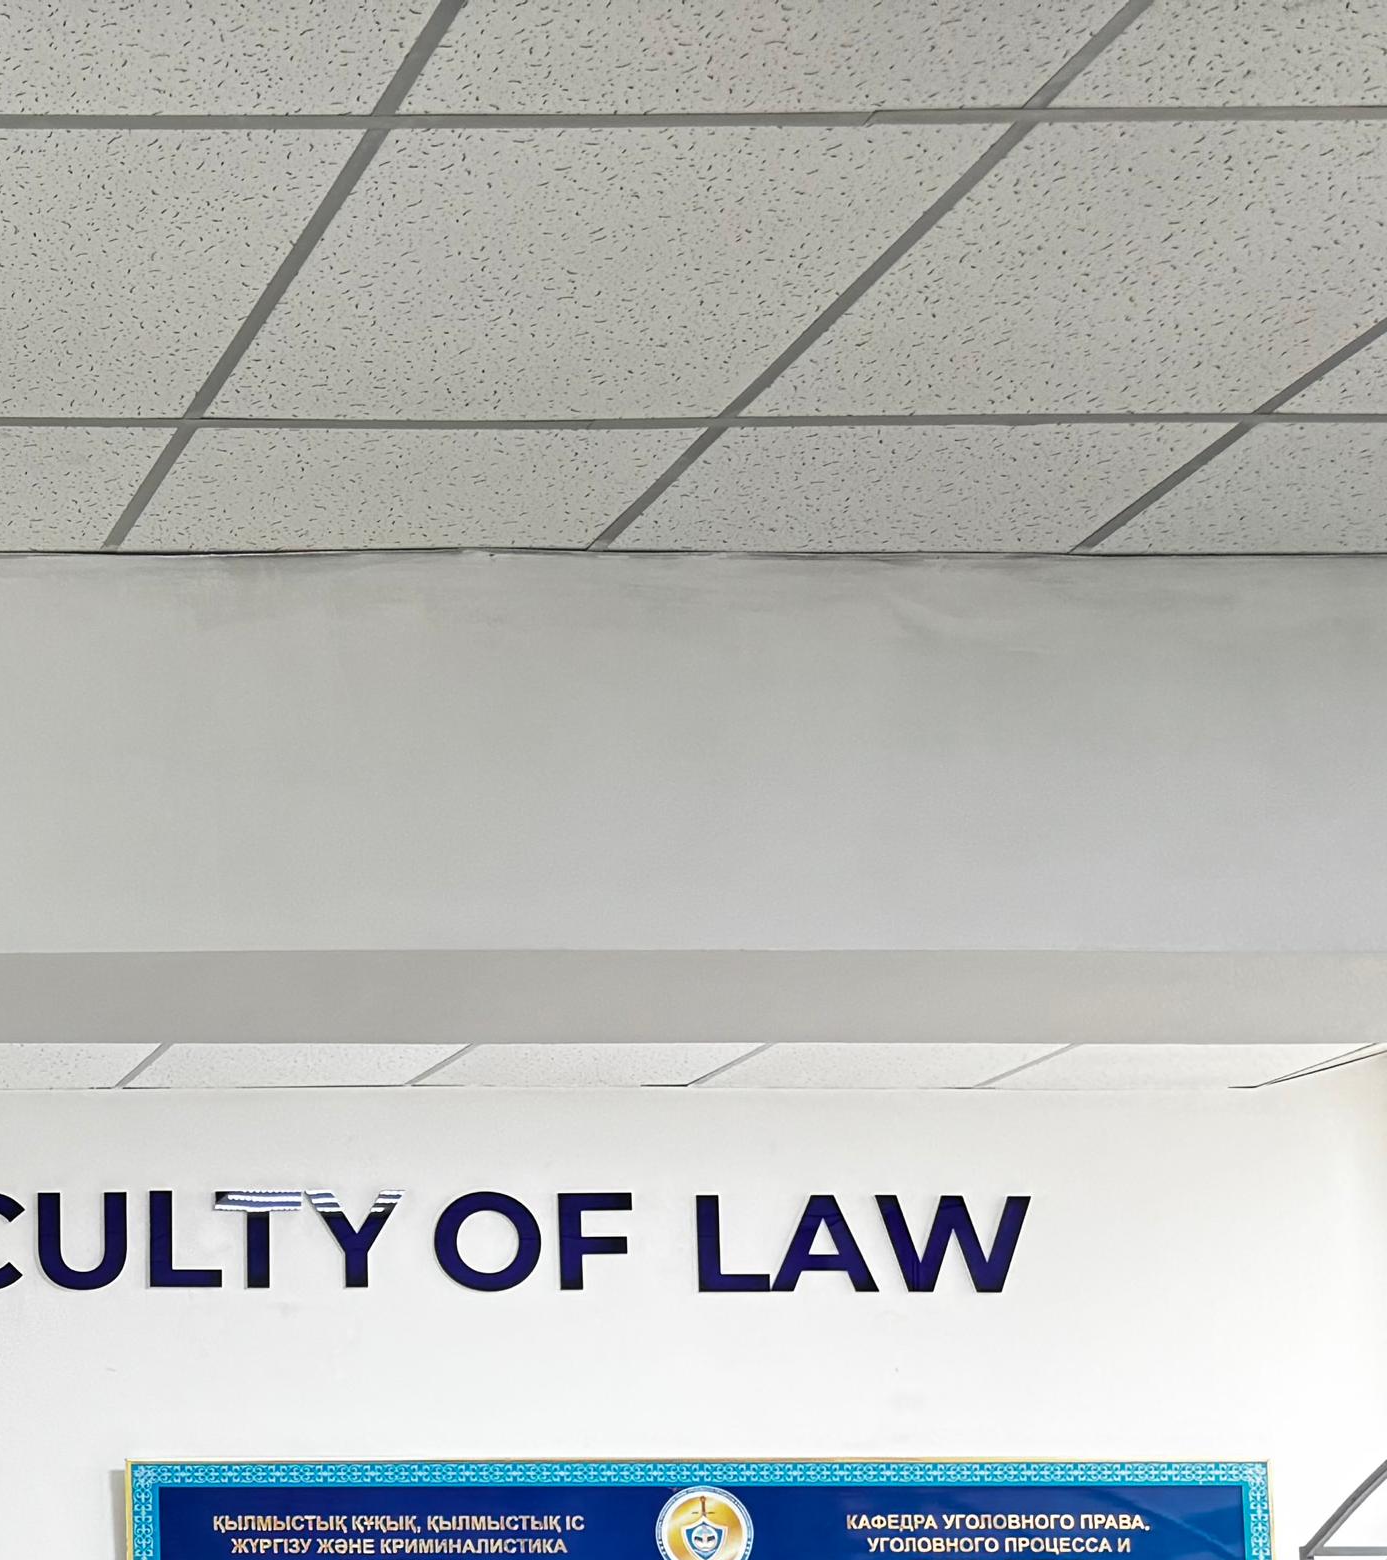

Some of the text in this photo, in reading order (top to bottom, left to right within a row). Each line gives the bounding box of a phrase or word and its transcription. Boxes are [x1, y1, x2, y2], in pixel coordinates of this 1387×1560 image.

[434, 1192, 632, 1292] OF
[696, 1195, 1031, 1293] LAW
[214, 1515, 347, 1533] ҚЫЛМЫСТЫҚ
[427, 1516, 561, 1533] ҚЫЛМЫСТЫҚ
[847, 1514, 938, 1532] КАФЕДРА
[942, 1514, 1075, 1530] УГОЛОВНОГО
[231, 1538, 567, 1554] ЖҮРГІЗУ ЖӘНЕ КРИМИНАЛИСТИКА
[867, 1537, 1130, 1555] УГОЛОВНОГО ПРОЦЕССА И
